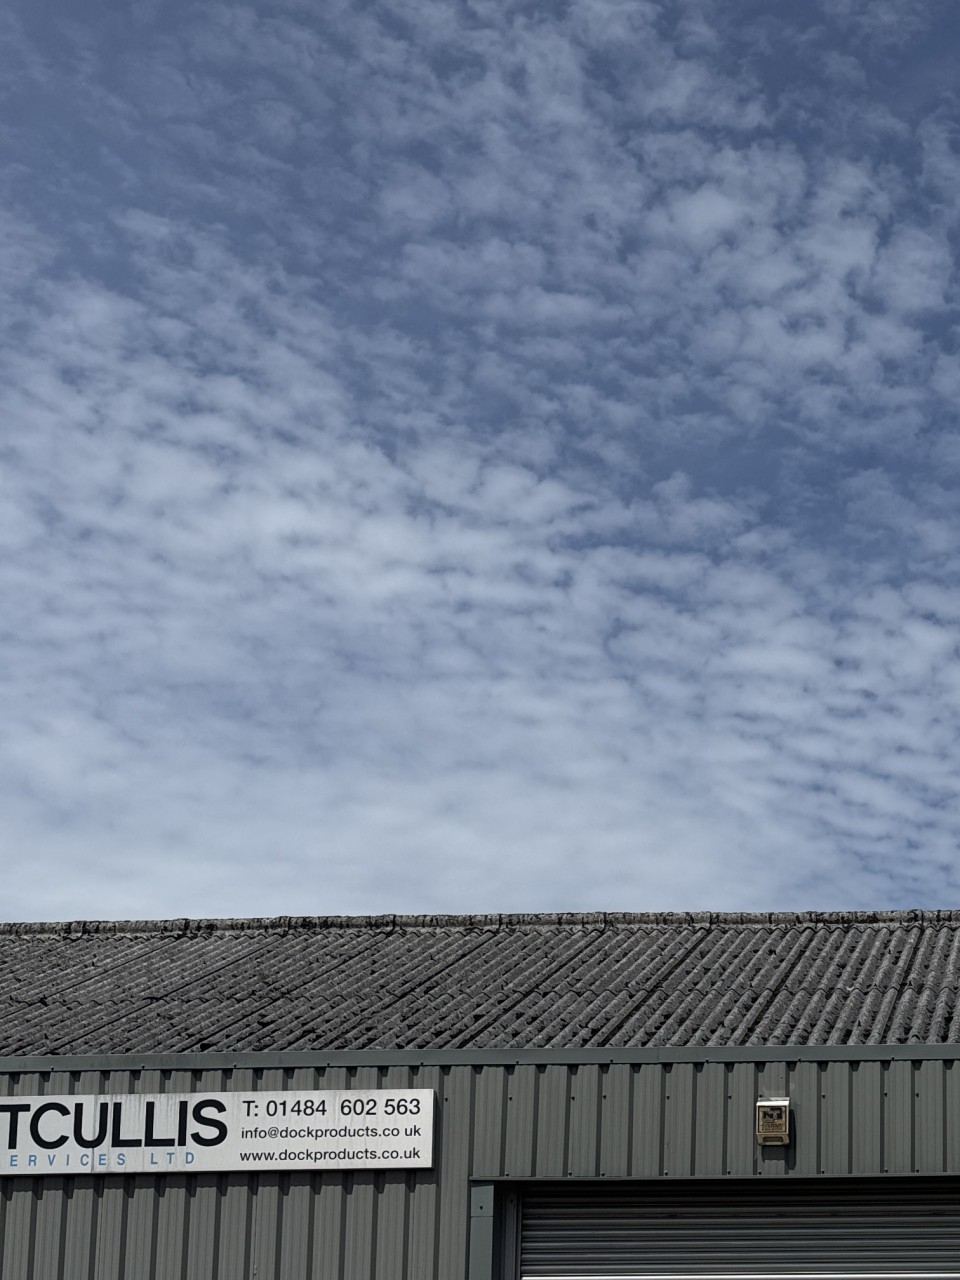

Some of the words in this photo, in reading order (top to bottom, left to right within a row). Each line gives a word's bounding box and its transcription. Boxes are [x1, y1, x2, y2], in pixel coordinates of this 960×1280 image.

[242, 1100, 259, 1117] T:
[265, 1099, 327, 1117] 01484
[340, 1099, 377, 1116] 602
[384, 1098, 421, 1115] 563
[0, 1099, 228, 1150] TCULLIS
[10, 1153, 126, 1167] ERVICES
[150, 1152, 195, 1165] LTD
[240, 1147, 420, 1163] www.dockproducts.co.uk
